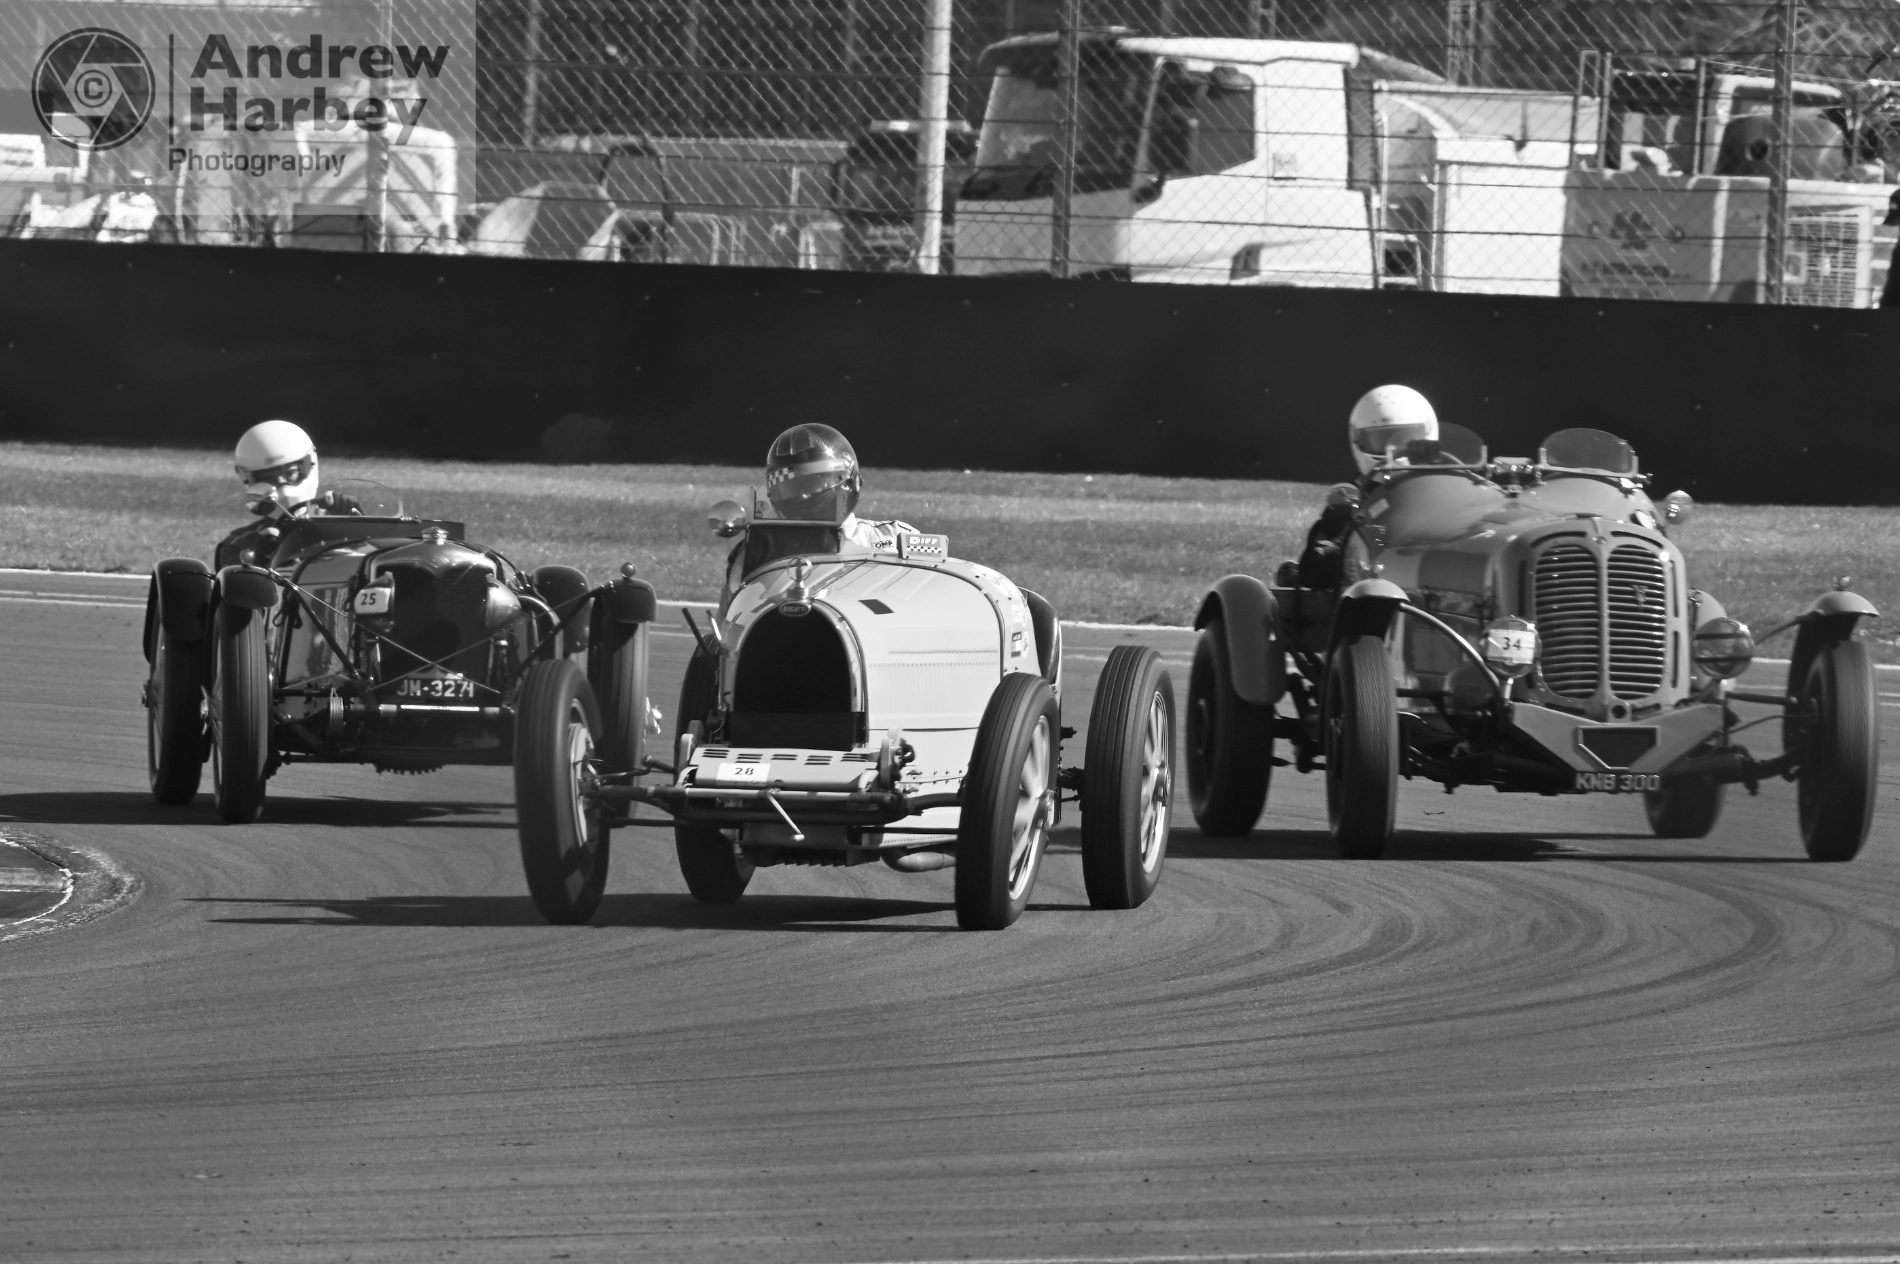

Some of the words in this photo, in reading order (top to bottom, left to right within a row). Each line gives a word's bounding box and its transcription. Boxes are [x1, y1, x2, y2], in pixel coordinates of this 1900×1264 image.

[909, 536, 938, 545] DIFF
[361, 592, 377, 606] 25
[1502, 636, 1521, 651] 34
[734, 767, 754, 776] 28
[1619, 774, 1660, 791] 300
